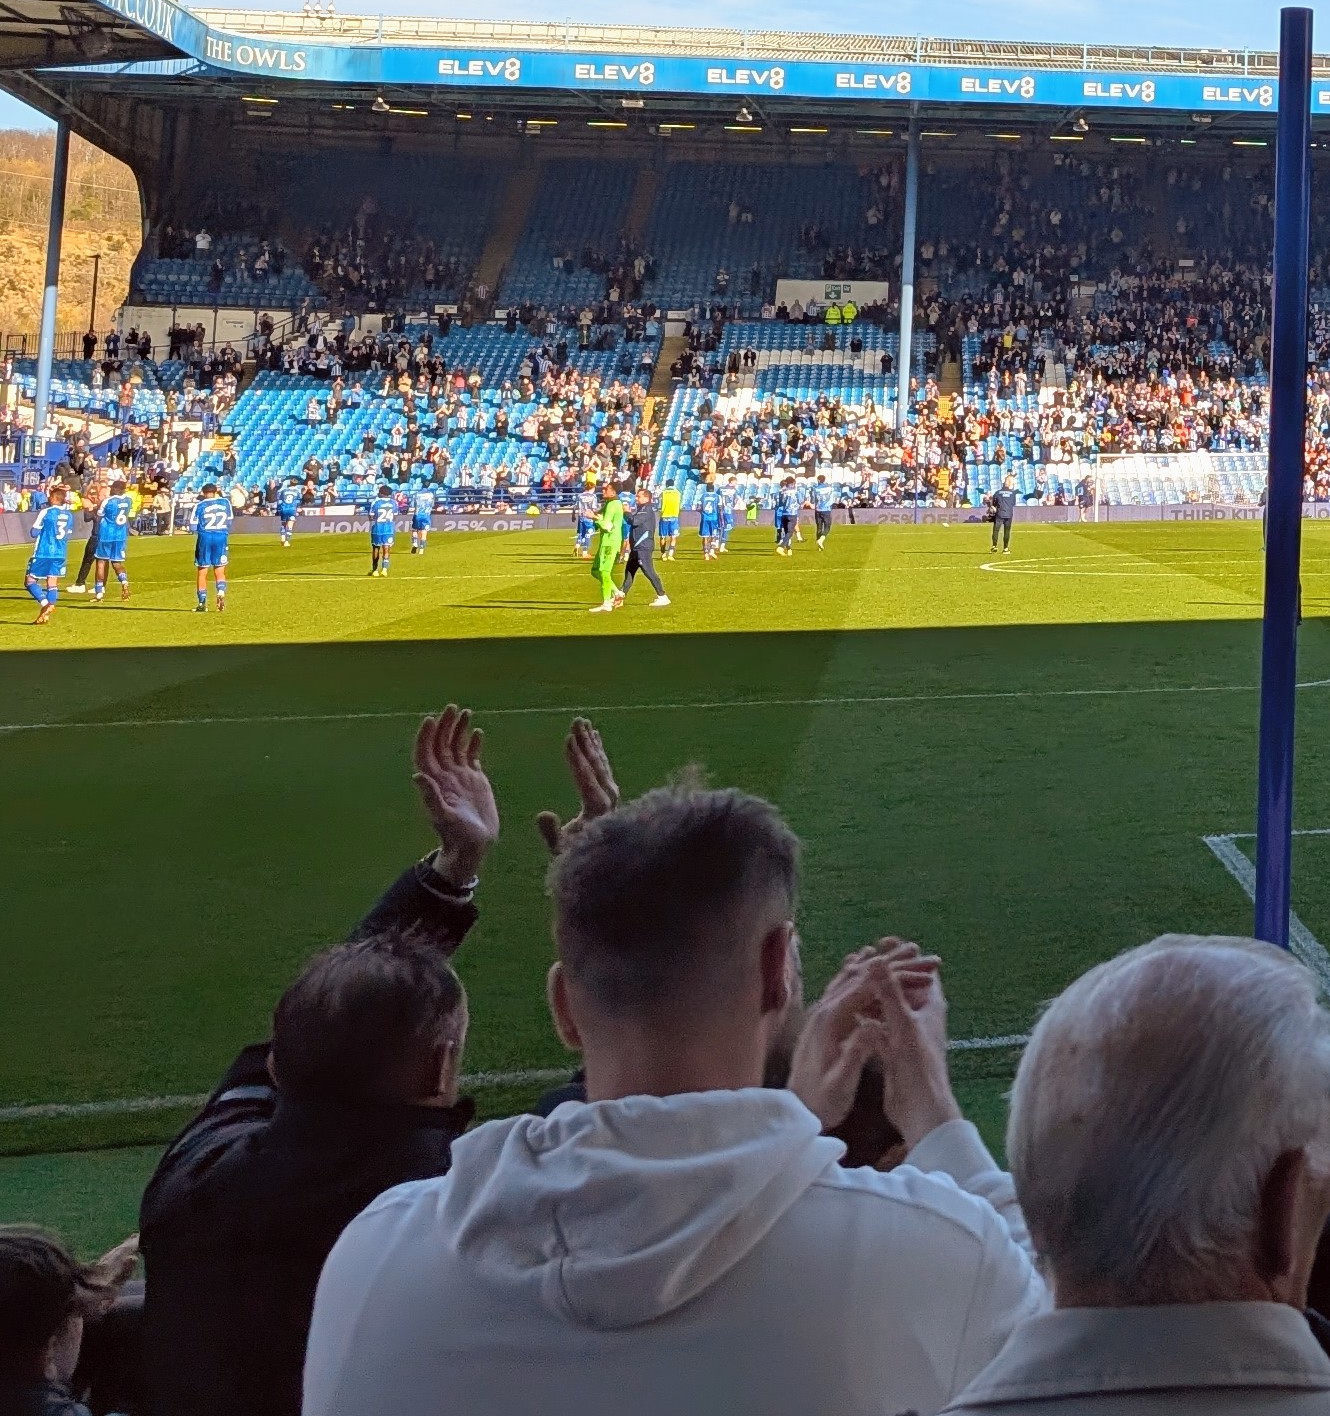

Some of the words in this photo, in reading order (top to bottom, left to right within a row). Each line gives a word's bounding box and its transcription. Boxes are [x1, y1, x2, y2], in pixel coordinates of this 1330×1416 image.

[206, 36, 232, 62] THE
[236, 45, 306, 71] OWLS
[438, 57, 521, 81] ELEV8
[575, 61, 655, 85] ELEV8
[707, 66, 785, 90] ELEV8
[836, 71, 912, 94] ELEV8
[961, 76, 1035, 98] ELEV8
[1083, 80, 1155, 102] ELEV8
[1203, 85, 1273, 107] ELEV8
[116, 512, 127, 525] 6
[377, 509, 394, 522] 24
[705, 503, 713, 513] 4
[1171, 508, 1226, 521] THIRD
[1231, 508, 1260, 520] KIT
[56, 520, 67, 540] 3
[204, 512, 228, 530] 22
[320, 520, 370, 533] HOM
[444, 520, 487, 532] 25%
[494, 519, 534, 531] OFF
